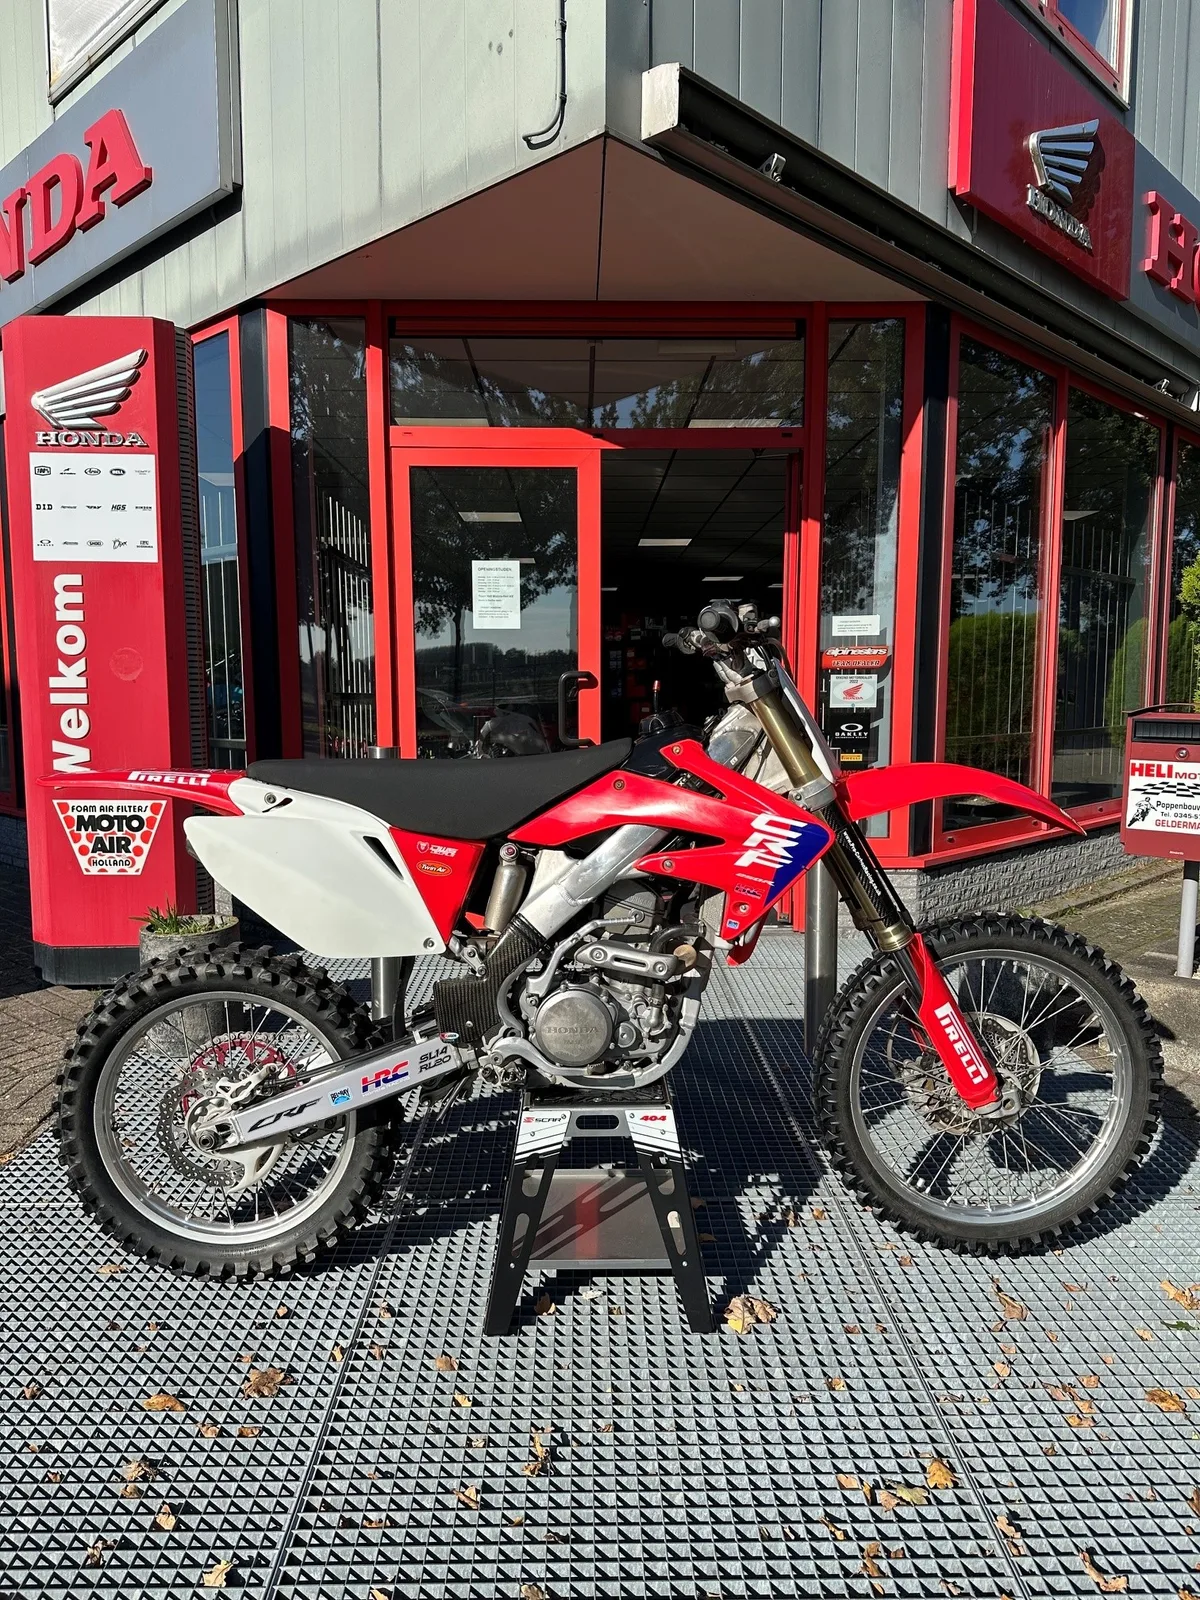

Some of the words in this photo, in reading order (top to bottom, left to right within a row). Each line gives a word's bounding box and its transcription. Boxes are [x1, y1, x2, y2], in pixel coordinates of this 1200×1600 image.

[1025, 183, 1093, 250] HONDA
[1143, 190, 1200, 312] H
[35, 431, 149, 447] HONDA
[826, 647, 887, 657] alpinestars
[48, 574, 91, 782] Welkom
[127, 771, 211, 786] PIRELLI
[1131, 763, 1173, 778] HELI
[71, 805, 97, 813] FOAM
[99, 805, 114, 813] AIR
[116, 805, 148, 813] FILTERS
[75, 814, 145, 832] MOTO
[91, 836, 131, 854] AIR
[733, 813, 808, 868] CRF
[92, 859, 131, 867] HOLLAND
[421, 863, 436, 872] Twin
[546, 1026, 600, 1034] HONDA
[934, 1002, 988, 1084] PIRELLI
[419, 1045, 448, 1064] SL14
[417, 1054, 451, 1074] RL20
[361, 1060, 409, 1093] HRC
[248, 1096, 323, 1133] CRF
